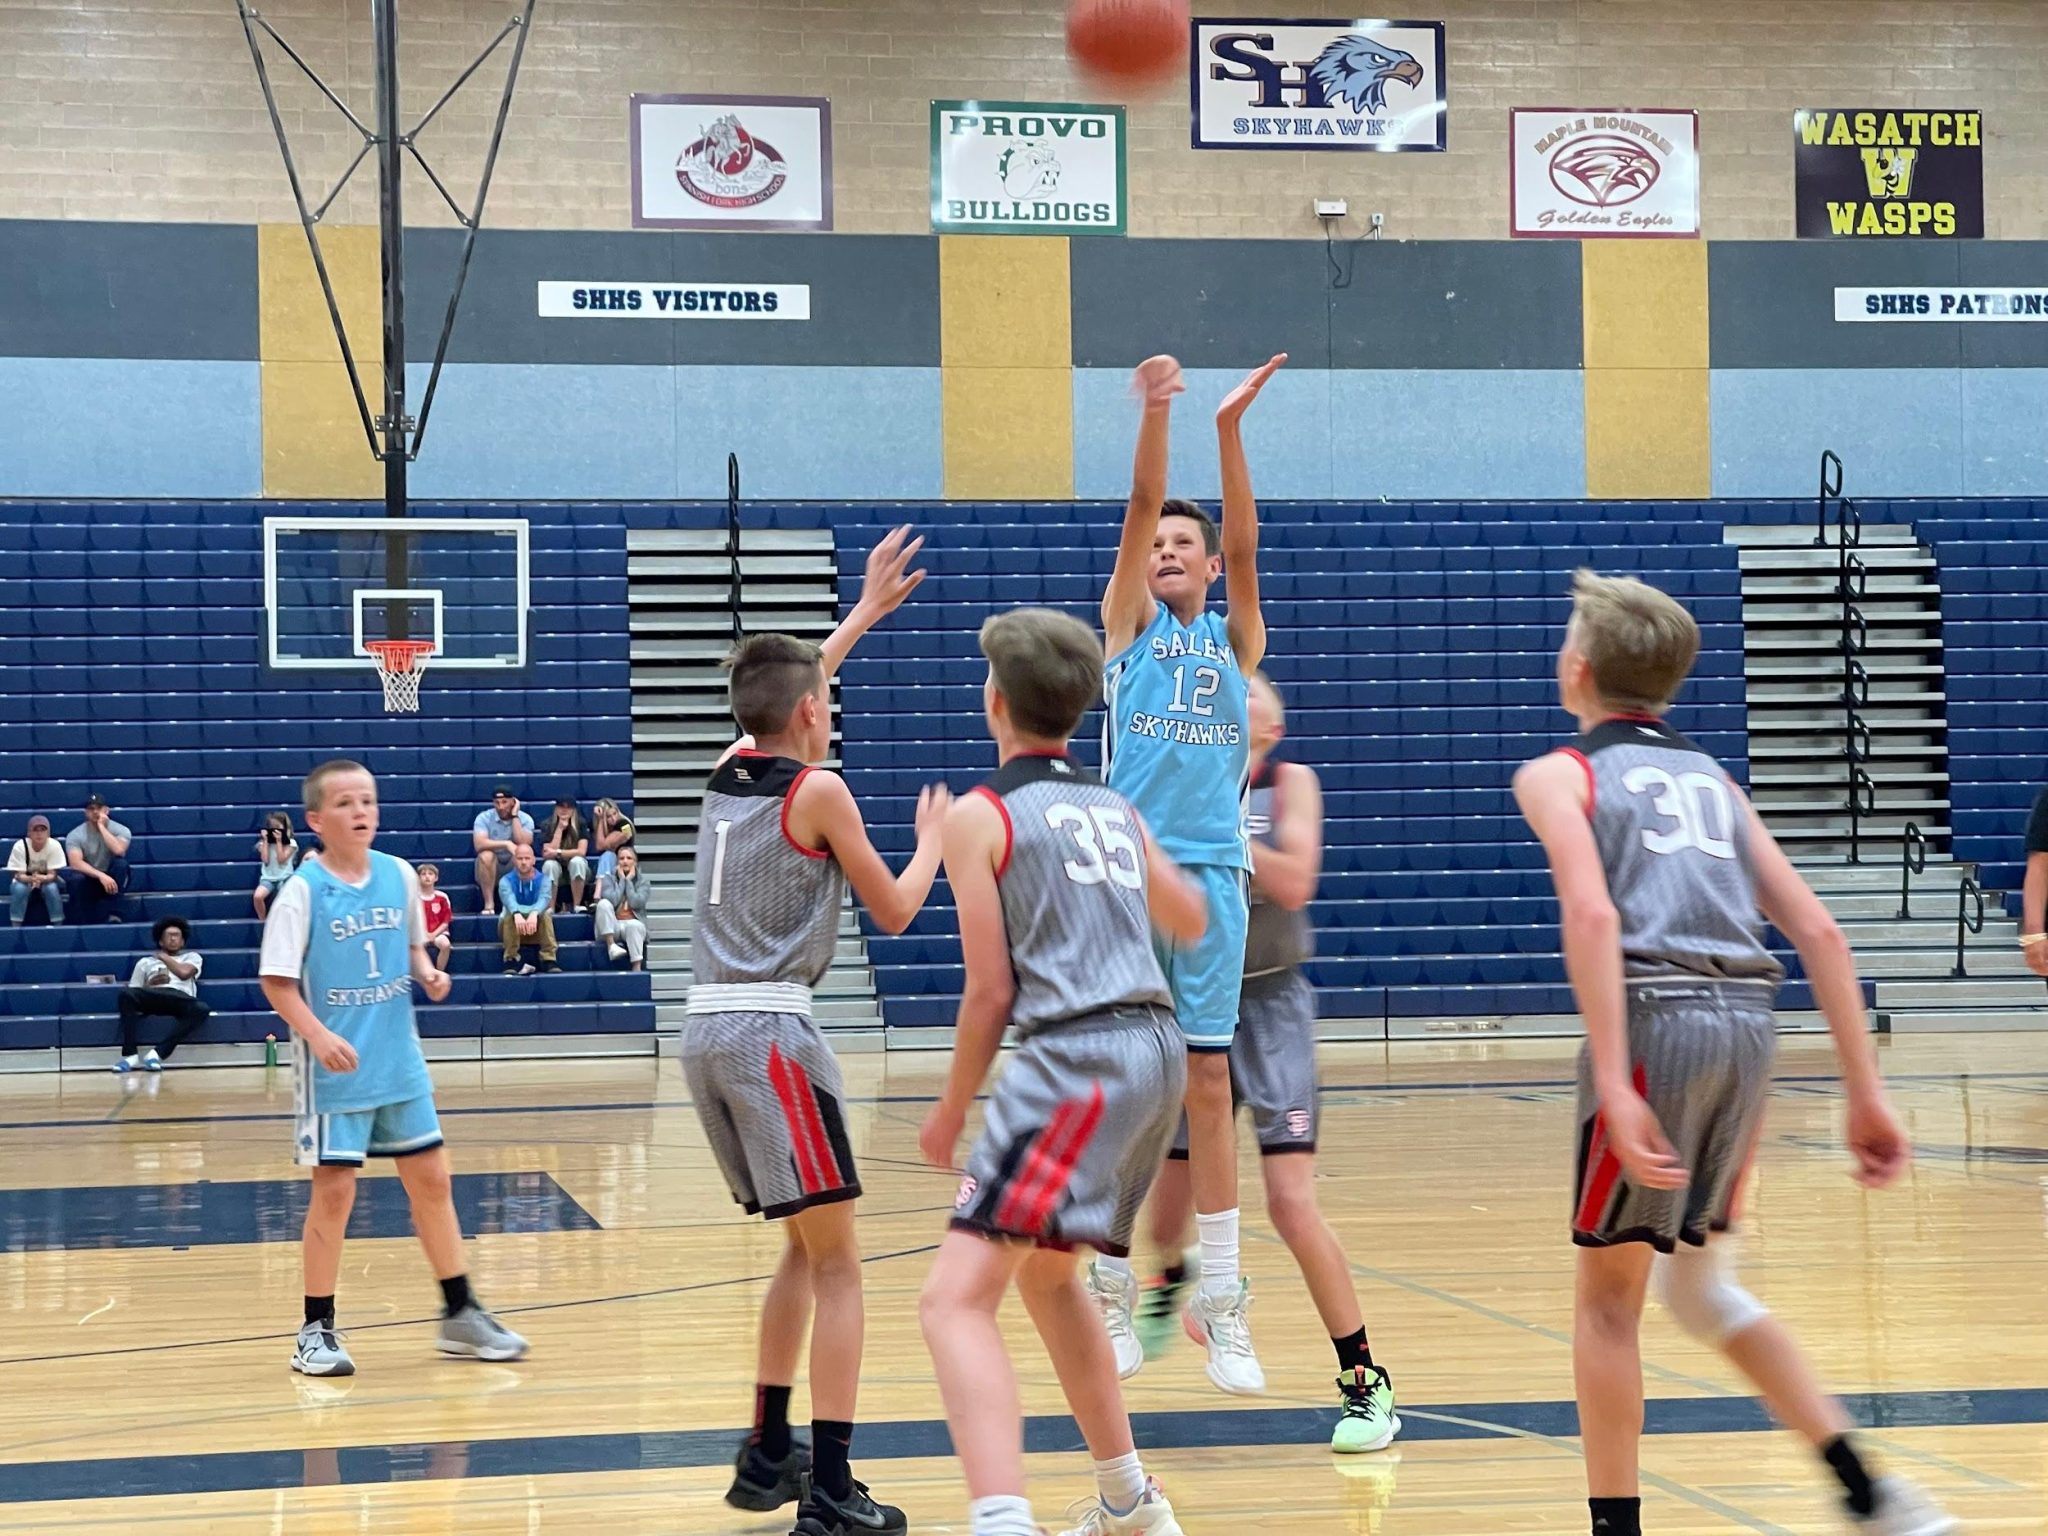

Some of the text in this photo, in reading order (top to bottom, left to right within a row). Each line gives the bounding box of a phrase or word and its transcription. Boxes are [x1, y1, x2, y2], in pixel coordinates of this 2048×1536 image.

[949, 115, 1106, 138] PROVO
[1534, 118, 1587, 155] MAPLE
[1800, 112, 1981, 146] WASATCH
[947, 200, 1111, 222] BULLDOGS
[1536, 208, 1674, 229] Golden Eagles
[1826, 201, 1956, 235] WASPS
[572, 288, 778, 312] SHHS VISITORS
[1866, 294, 1930, 314] SHHS
[1167, 664, 1221, 717] 12
[1129, 711, 1240, 746] SKYHAWKS
[1621, 765, 1737, 859] 30
[708, 819, 733, 906] 1
[1043, 802, 1143, 890] 35
[363, 939, 382, 979] 1
